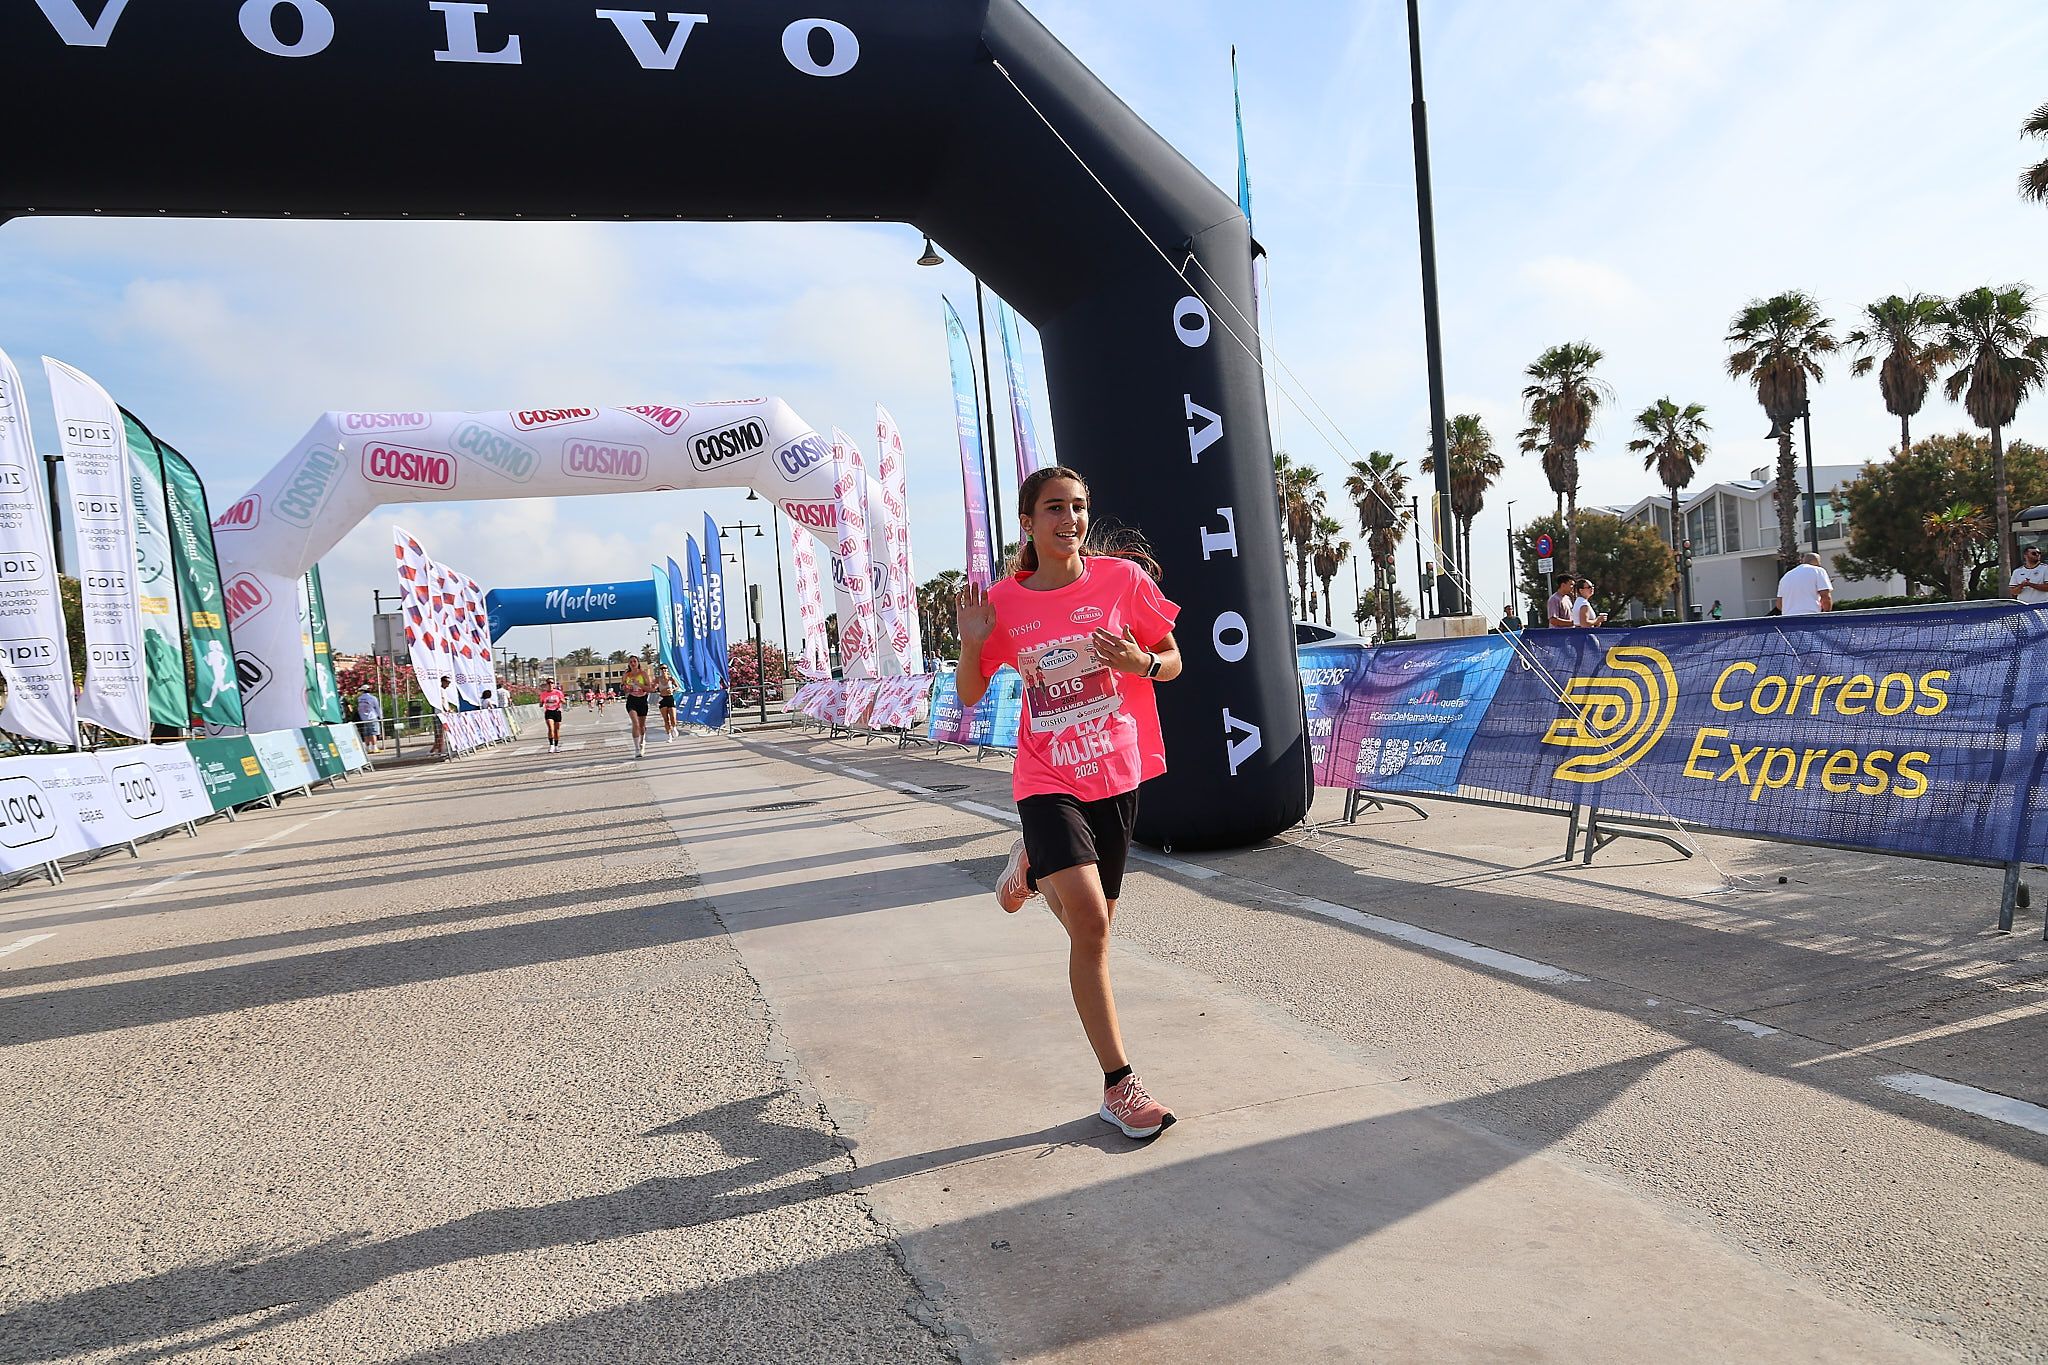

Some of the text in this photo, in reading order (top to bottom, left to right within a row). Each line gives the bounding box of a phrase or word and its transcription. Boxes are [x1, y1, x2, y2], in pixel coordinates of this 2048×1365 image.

[34, 0, 860, 77] VOLVO
[346, 412, 425, 430] COSMO
[518, 408, 591, 426] COSMO
[457, 424, 533, 478] COSMO
[569, 443, 642, 477] COSMO
[695, 421, 764, 466] COSMO
[370, 447, 449, 485] COSMO
[279, 449, 342, 520] COSMO
[1173, 295, 1262, 776] VOLVO
[545, 587, 616, 619] Marlene
[1041, 653, 1076, 667] ASTURIANA
[1048, 677, 1084, 699] 016
[1710, 662, 1951, 718] Correos
[1041, 716, 1067, 728] OYSHO
[1051, 730, 1115, 767] MUJER
[1683, 727, 1931, 801] Express
[1075, 761, 1099, 779] 2026
[119, 777, 157, 807] ziaja
